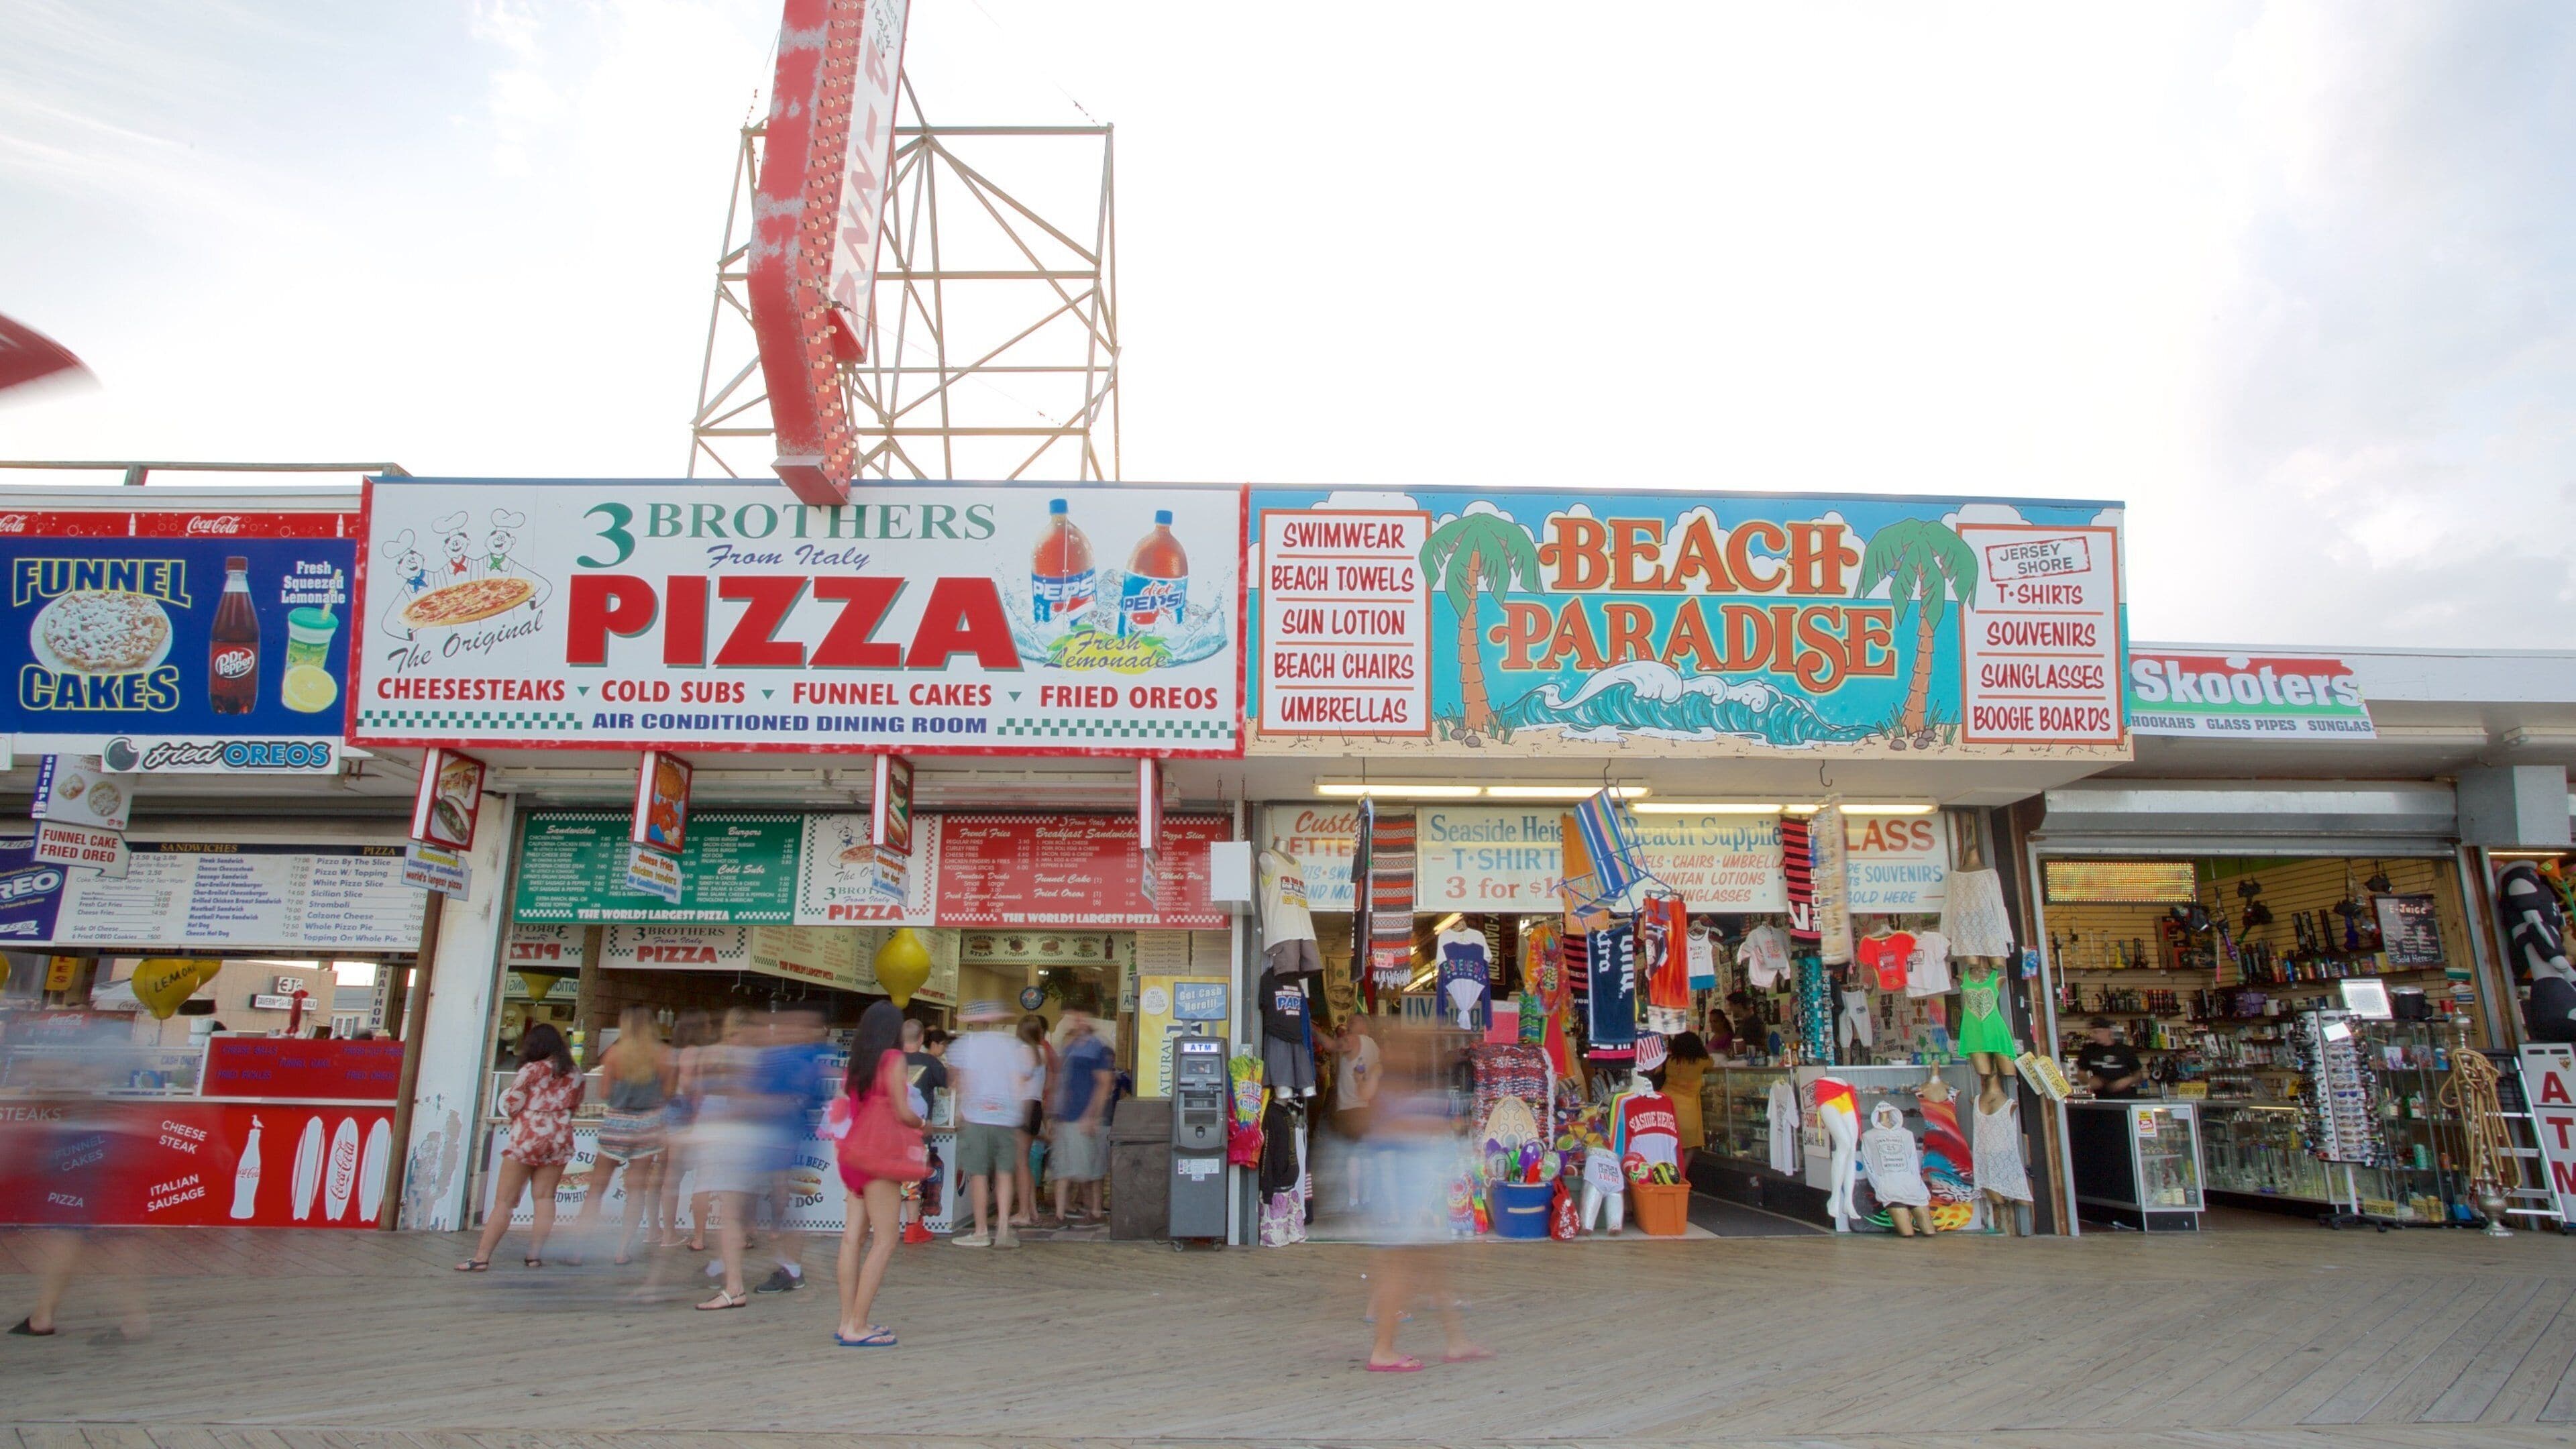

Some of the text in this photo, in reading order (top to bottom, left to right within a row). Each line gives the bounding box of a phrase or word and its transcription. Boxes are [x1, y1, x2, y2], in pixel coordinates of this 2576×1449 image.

[577, 502, 996, 569] 3 BROTHERS
[1282, 522, 1406, 549] SWIMWEAR
[706, 543, 871, 570] From Italy
[1538, 516, 1860, 595] BEACH
[1998, 543, 2061, 562] JERSEY
[296, 561, 331, 575] Fresh
[2017, 555, 2074, 575] SHORE
[13, 558, 191, 608] FUNNEL
[284, 576, 344, 590] Squeezed
[1271, 565, 1415, 592] BEACH TOWELS
[280, 590, 345, 604] Lemonade
[1034, 576, 1097, 602] PEPSI
[1141, 582, 1173, 596] diet
[1123, 590, 1183, 612] PEPSI
[566, 574, 1025, 673] PIZZA
[1281, 609, 1405, 635] SUN LOTION
[387, 609, 545, 674] The Original
[1074, 631, 1141, 655] Fresh
[1986, 621, 2096, 647] SOUVENIRS
[1489, 596, 1896, 694] PARADISE
[229, 652, 245, 663] Dr
[1043, 641, 1167, 669] Lemonade
[215, 656, 254, 676] Pepper
[1274, 653, 1415, 680] BEACH CHAIRS
[1980, 663, 2105, 689] SUNGLASSES
[2131, 658, 2365, 708] Skooters
[19, 663, 179, 712] CAKES
[376, 678, 1218, 710] CHEESESTEAKS COLD SUBS FUNNEL CAKES FRIED OREOS
[1281, 696, 1408, 723] UMBRELLAS
[1973, 705, 2111, 732] BOOGIE BOARDS
[592, 712, 987, 733] AIR CONDITIONED DINING ROOM
[2130, 715, 2374, 733] HOOKAHS GLASS PIPES SUNGLAS
[142, 742, 330, 769] fried OREOS
[39, 756, 54, 800] SHRIMP
[545, 825, 596, 835] Sandwiches
[728, 826, 762, 838] Burgers
[959, 828, 1011, 838] French Fries
[1035, 827, 1138, 840] Breakfast Sandwiche
[1431, 814, 1516, 843] Seaside
[1623, 816, 1782, 853] Beach Supplie
[43, 829, 118, 849] FUNNEL CAKE
[160, 843, 238, 853] SANDWICHES
[40, 843, 115, 863] FRIED OREO
[363, 846, 396, 855] PIZZA
[341, 858, 353, 866] By
[355, 858, 370, 866] The
[638, 853, 674, 873] cheese fries
[717, 864, 765, 875] Cold Subs
[1672, 855, 1714, 868] CHAIRS
[354, 869, 388, 878] Topping
[631, 863, 654, 879] chicken
[835, 871, 855, 883] The
[1034, 873, 1091, 884] Funnel Cake
[1652, 871, 1766, 886] SUNTAN LOTIONS
[1864, 865, 1943, 883] SOUVENIRS
[406, 871, 463, 891] world's largest pizza
[1446, 876, 1520, 899] 3 for
[311, 890, 341, 898] Sicilian
[824, 887, 837, 900] 3
[843, 896, 865, 904] From
[1033, 888, 1085, 898] Fried Oreos
[1670, 888, 1752, 903] SUNGLASSES
[1847, 890, 1917, 904] SOLD HERE
[309, 900, 350, 908] Stromboli
[828, 904, 905, 920] PIZZA
[307, 911, 374, 920] Calzone Cheese
[578, 909, 729, 921] THE WORLDS LARGEST PIZZA
[1002, 913, 1161, 924] THE WORLDS LARGEST PIZZA
[305, 922, 373, 931] Whole Pizza Pie
[632, 926, 725, 942] 3 BROTHERS
[303, 933, 337, 943] Topping
[355, 934, 382, 943] Whole
[384, 935, 398, 943] Pie
[653, 936, 704, 946] From Italy
[637, 946, 718, 963] PIZZA
[257, 997, 276, 1006] TAVERN
[1179, 991, 1195, 1001] Get
[1198, 986, 1222, 998] Cash
[1407, 997, 1433, 1025] UV
[1190, 1043, 1212, 1051] ATM
[1240, 1099, 1261, 1113] GIRL
[161, 1120, 207, 1142] CHEESE
[1629, 1111, 1657, 1133] SEASIDE
[2541, 1071, 2576, 1195] ATM
[54, 1135, 106, 1159] FUNNEL
[158, 1134, 198, 1155] STEAK
[62, 1149, 104, 1172] CAKES
[806, 1155, 830, 1173] BEEF
[150, 1174, 200, 1196] ITALIAN
[47, 1192, 85, 1208] PIZZA
[147, 1186, 206, 1212] SAUSAGE
[794, 1193, 824, 1208] DOG
